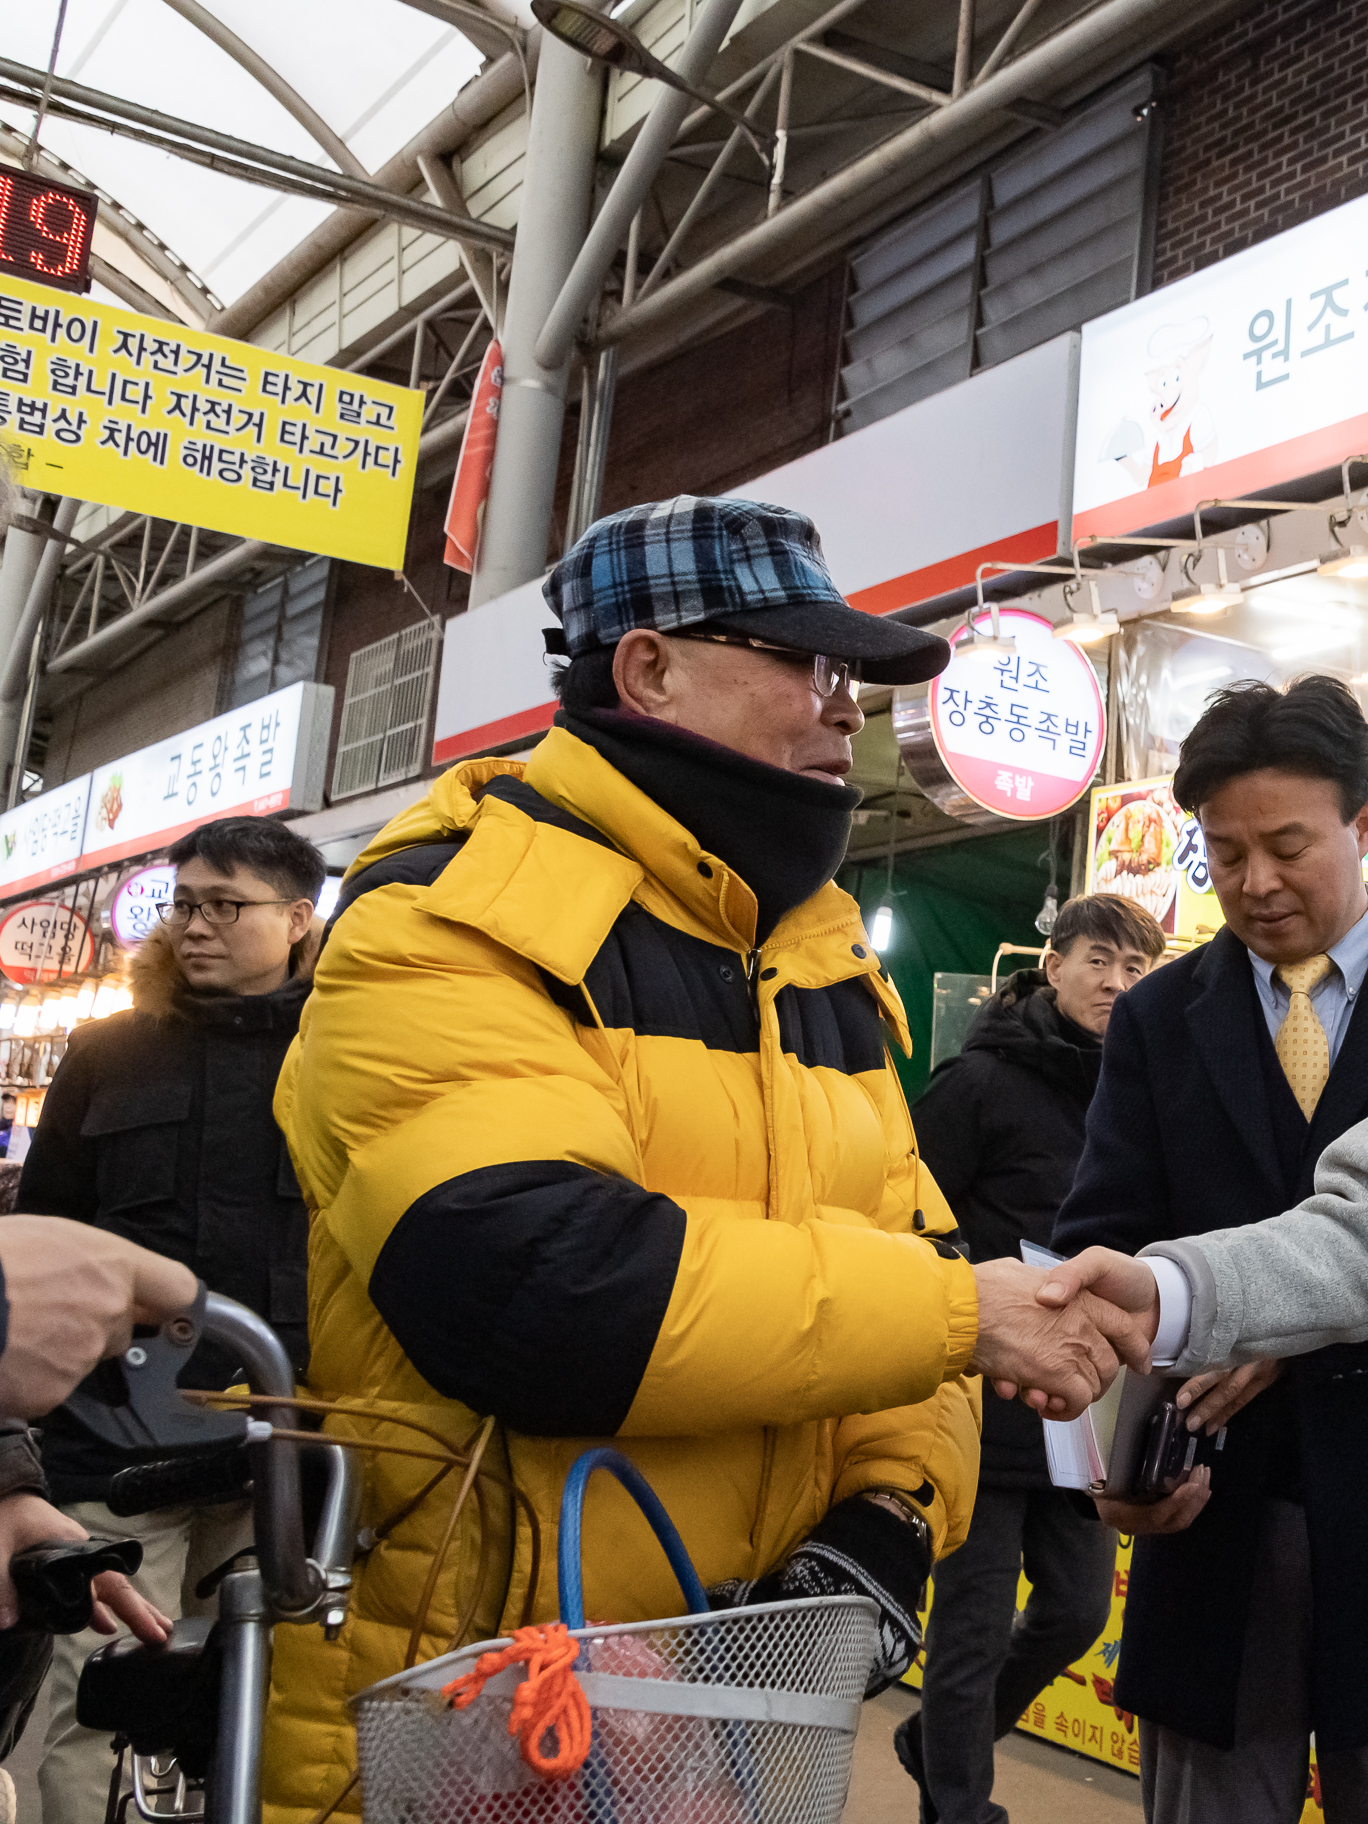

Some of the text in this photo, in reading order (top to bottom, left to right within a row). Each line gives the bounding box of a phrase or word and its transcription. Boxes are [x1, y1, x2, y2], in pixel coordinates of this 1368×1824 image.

[0, 343, 402, 478] 험 합니다 자전거 타고가다
[112, 328, 247, 393] 자전거는
[261, 370, 325, 414] 타지
[336, 388, 396, 431] 말고
[100, 418, 168, 466] 차에
[182, 439, 344, 507] 해당합니다
[993, 656, 1050, 693] 원조
[163, 708, 281, 806] 교동왕족발
[942, 686, 1092, 758] 장충동족발
[994, 769, 1035, 802] 족발
[17, 917, 79, 940] 사임당
[1054, 1710, 1104, 1752] 속이지
